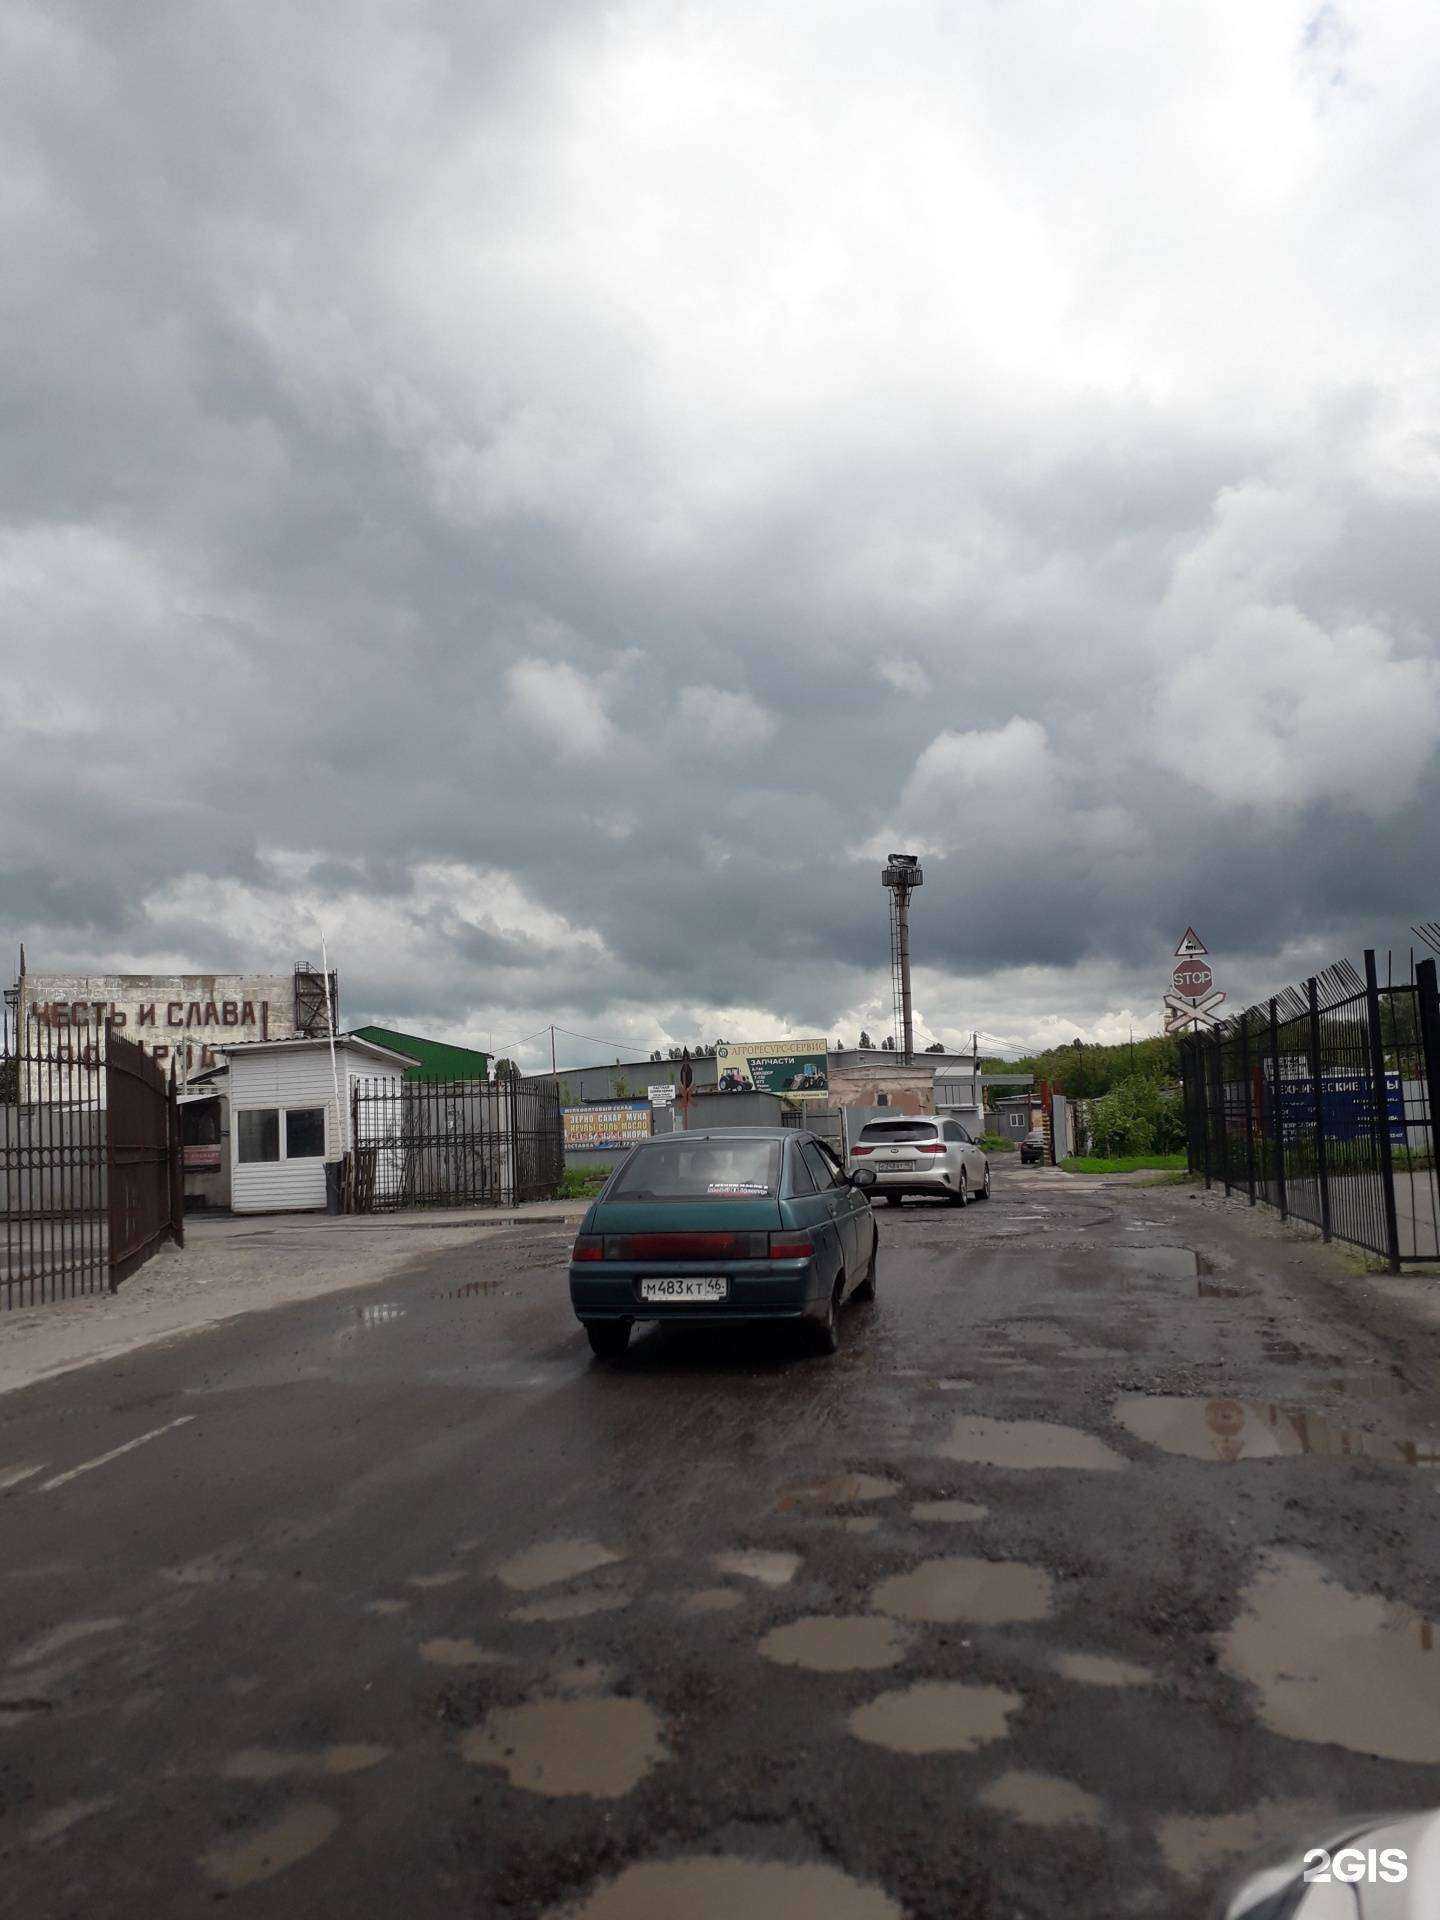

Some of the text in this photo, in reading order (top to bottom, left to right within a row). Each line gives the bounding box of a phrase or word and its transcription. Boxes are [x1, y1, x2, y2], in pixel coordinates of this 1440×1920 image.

[1174, 972, 1211, 985] STOP
[32, 1001, 126, 1028] ЧЕСТЬ
[139, 1003, 156, 1026] И
[750, 1057, 795, 1066] ЗАПЧАСТИ
[570, 1112, 647, 1124] ЗЕРНО САХАР МУКА
[570, 1121, 647, 1132] КРУПЫ СОЛЬ МАСЛО
[647, 1279, 722, 1294] М483КТ 46
